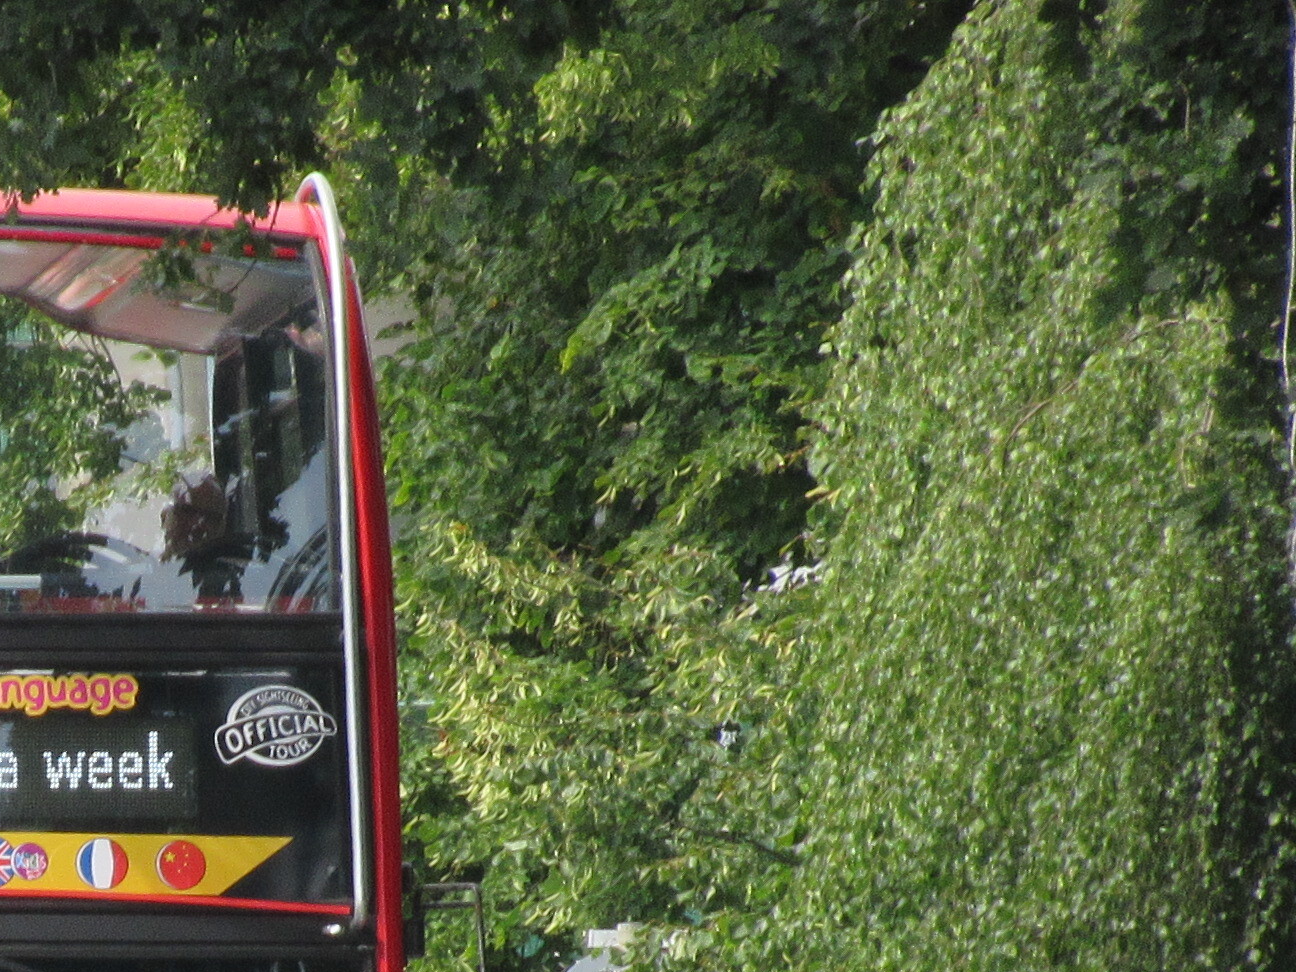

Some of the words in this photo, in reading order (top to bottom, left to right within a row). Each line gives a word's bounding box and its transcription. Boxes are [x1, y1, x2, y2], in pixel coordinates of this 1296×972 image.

[225, 714, 332, 754] OFFICIAL
[270, 738, 313, 760] TOUR
[43, 730, 175, 789] week
